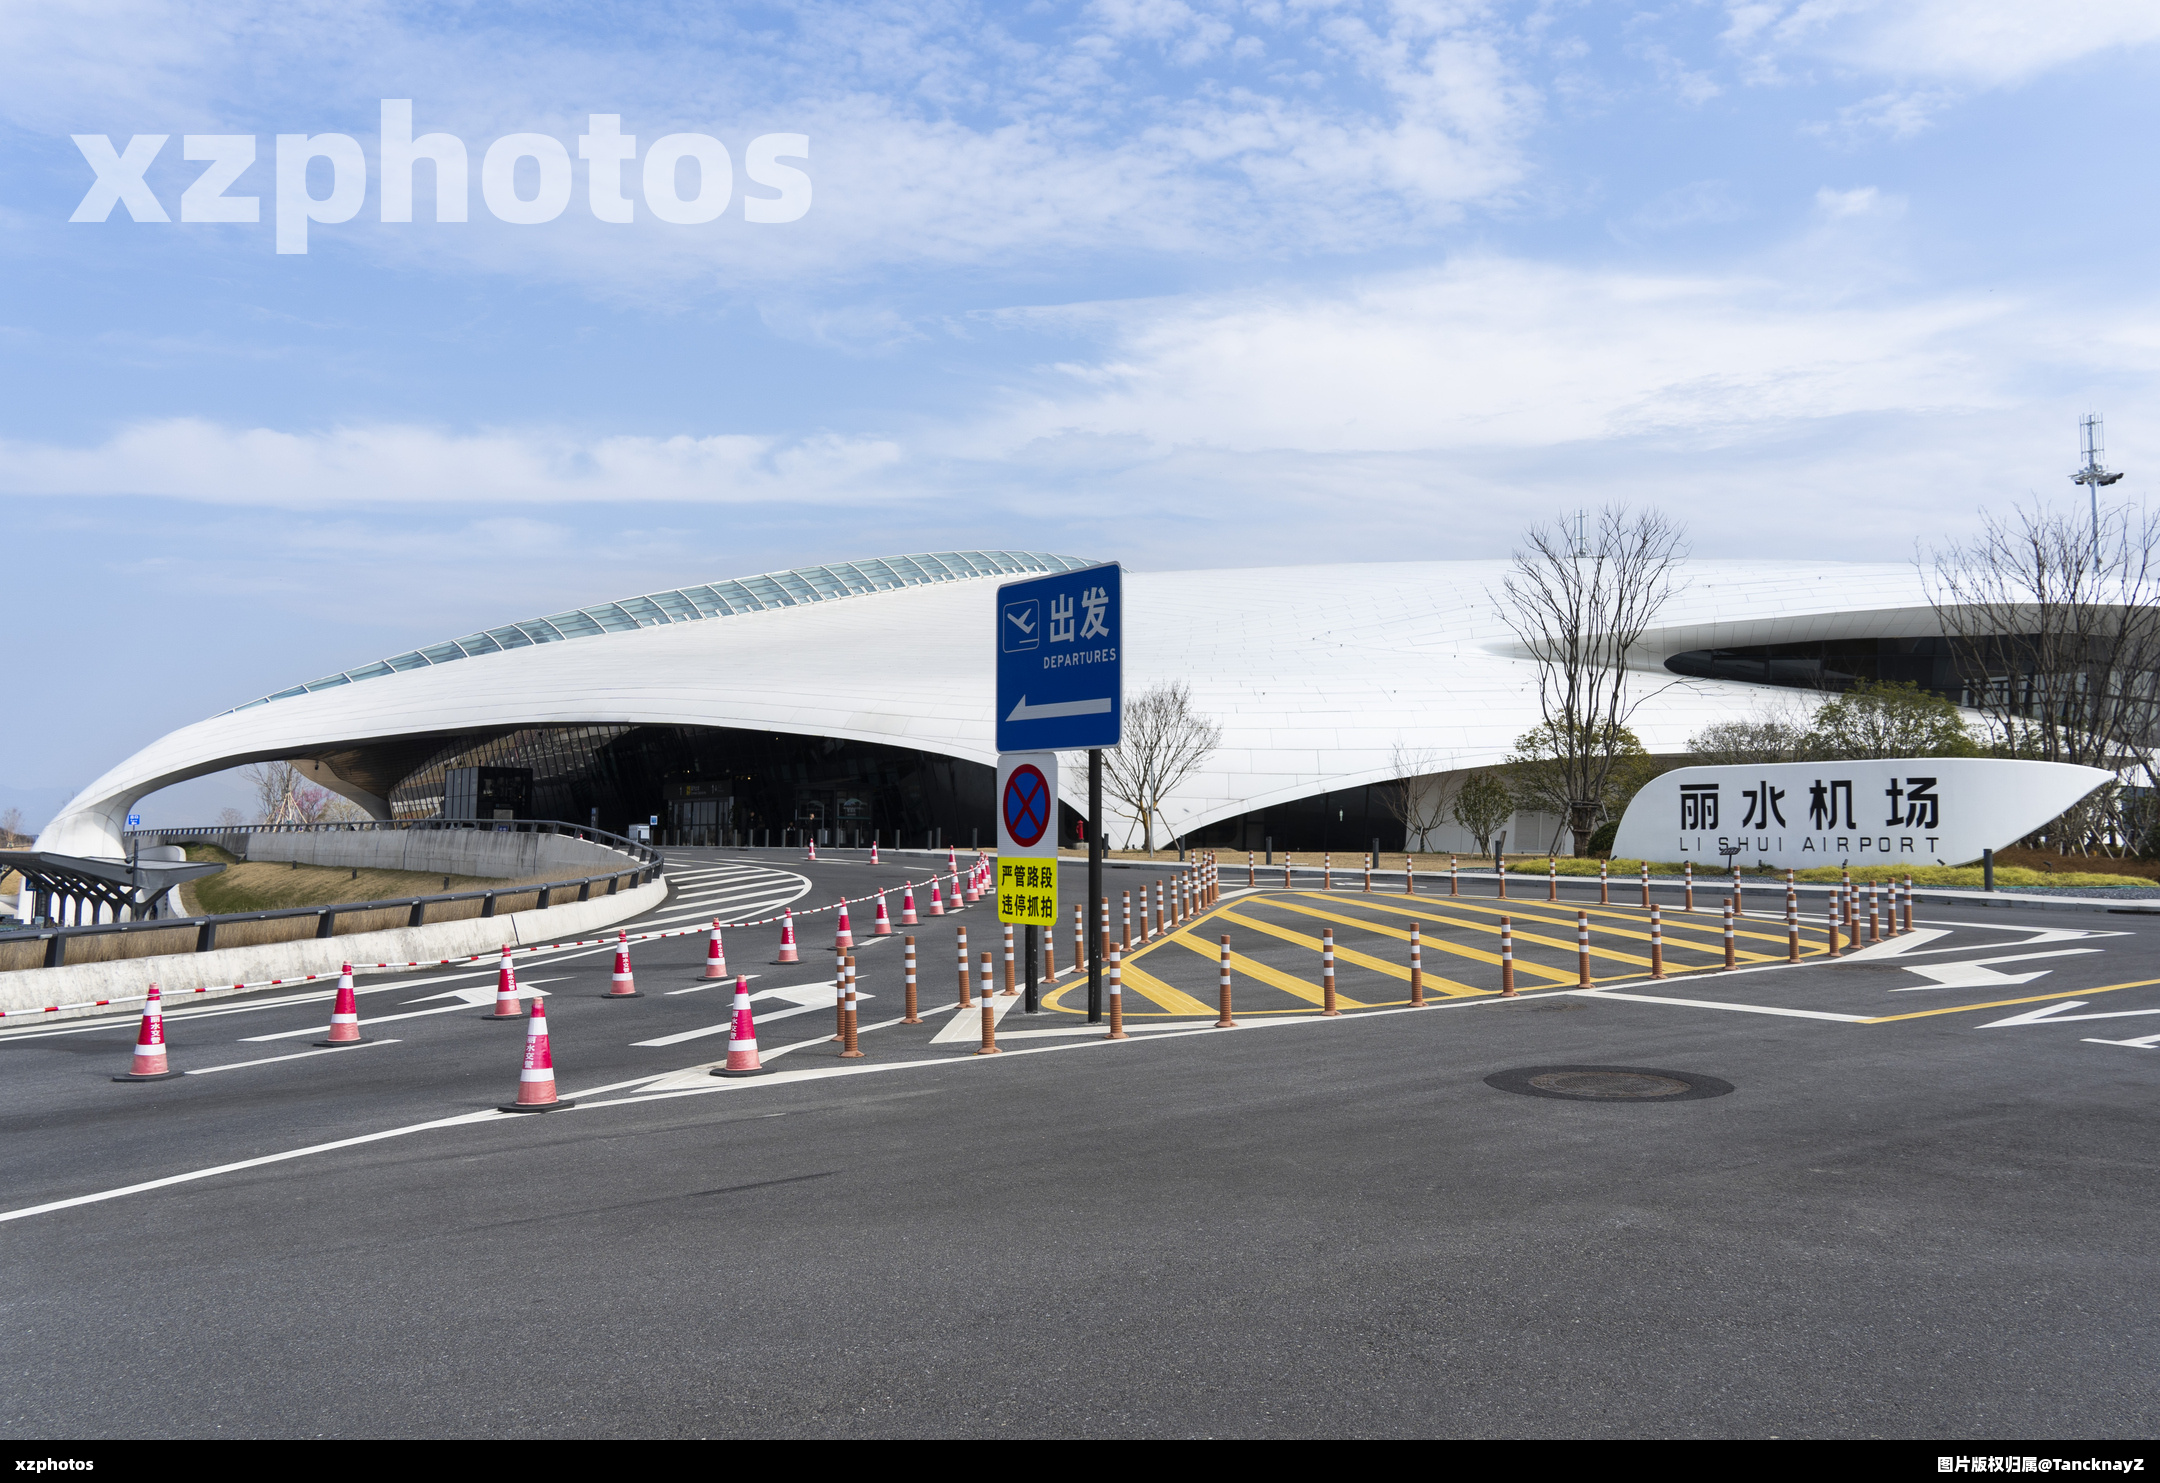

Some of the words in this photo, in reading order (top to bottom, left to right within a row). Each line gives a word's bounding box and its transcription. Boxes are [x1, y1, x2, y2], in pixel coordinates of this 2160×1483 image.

[1050, 587, 1109, 643] 出发
[1044, 648, 1117, 669] DEPARTURES
[1679, 777, 1939, 830] 丽水机场
[1802, 837, 1940, 853] AIRPORT
[1001, 865, 1053, 888] 严管路段
[1002, 894, 1052, 918] 违停抓拍
